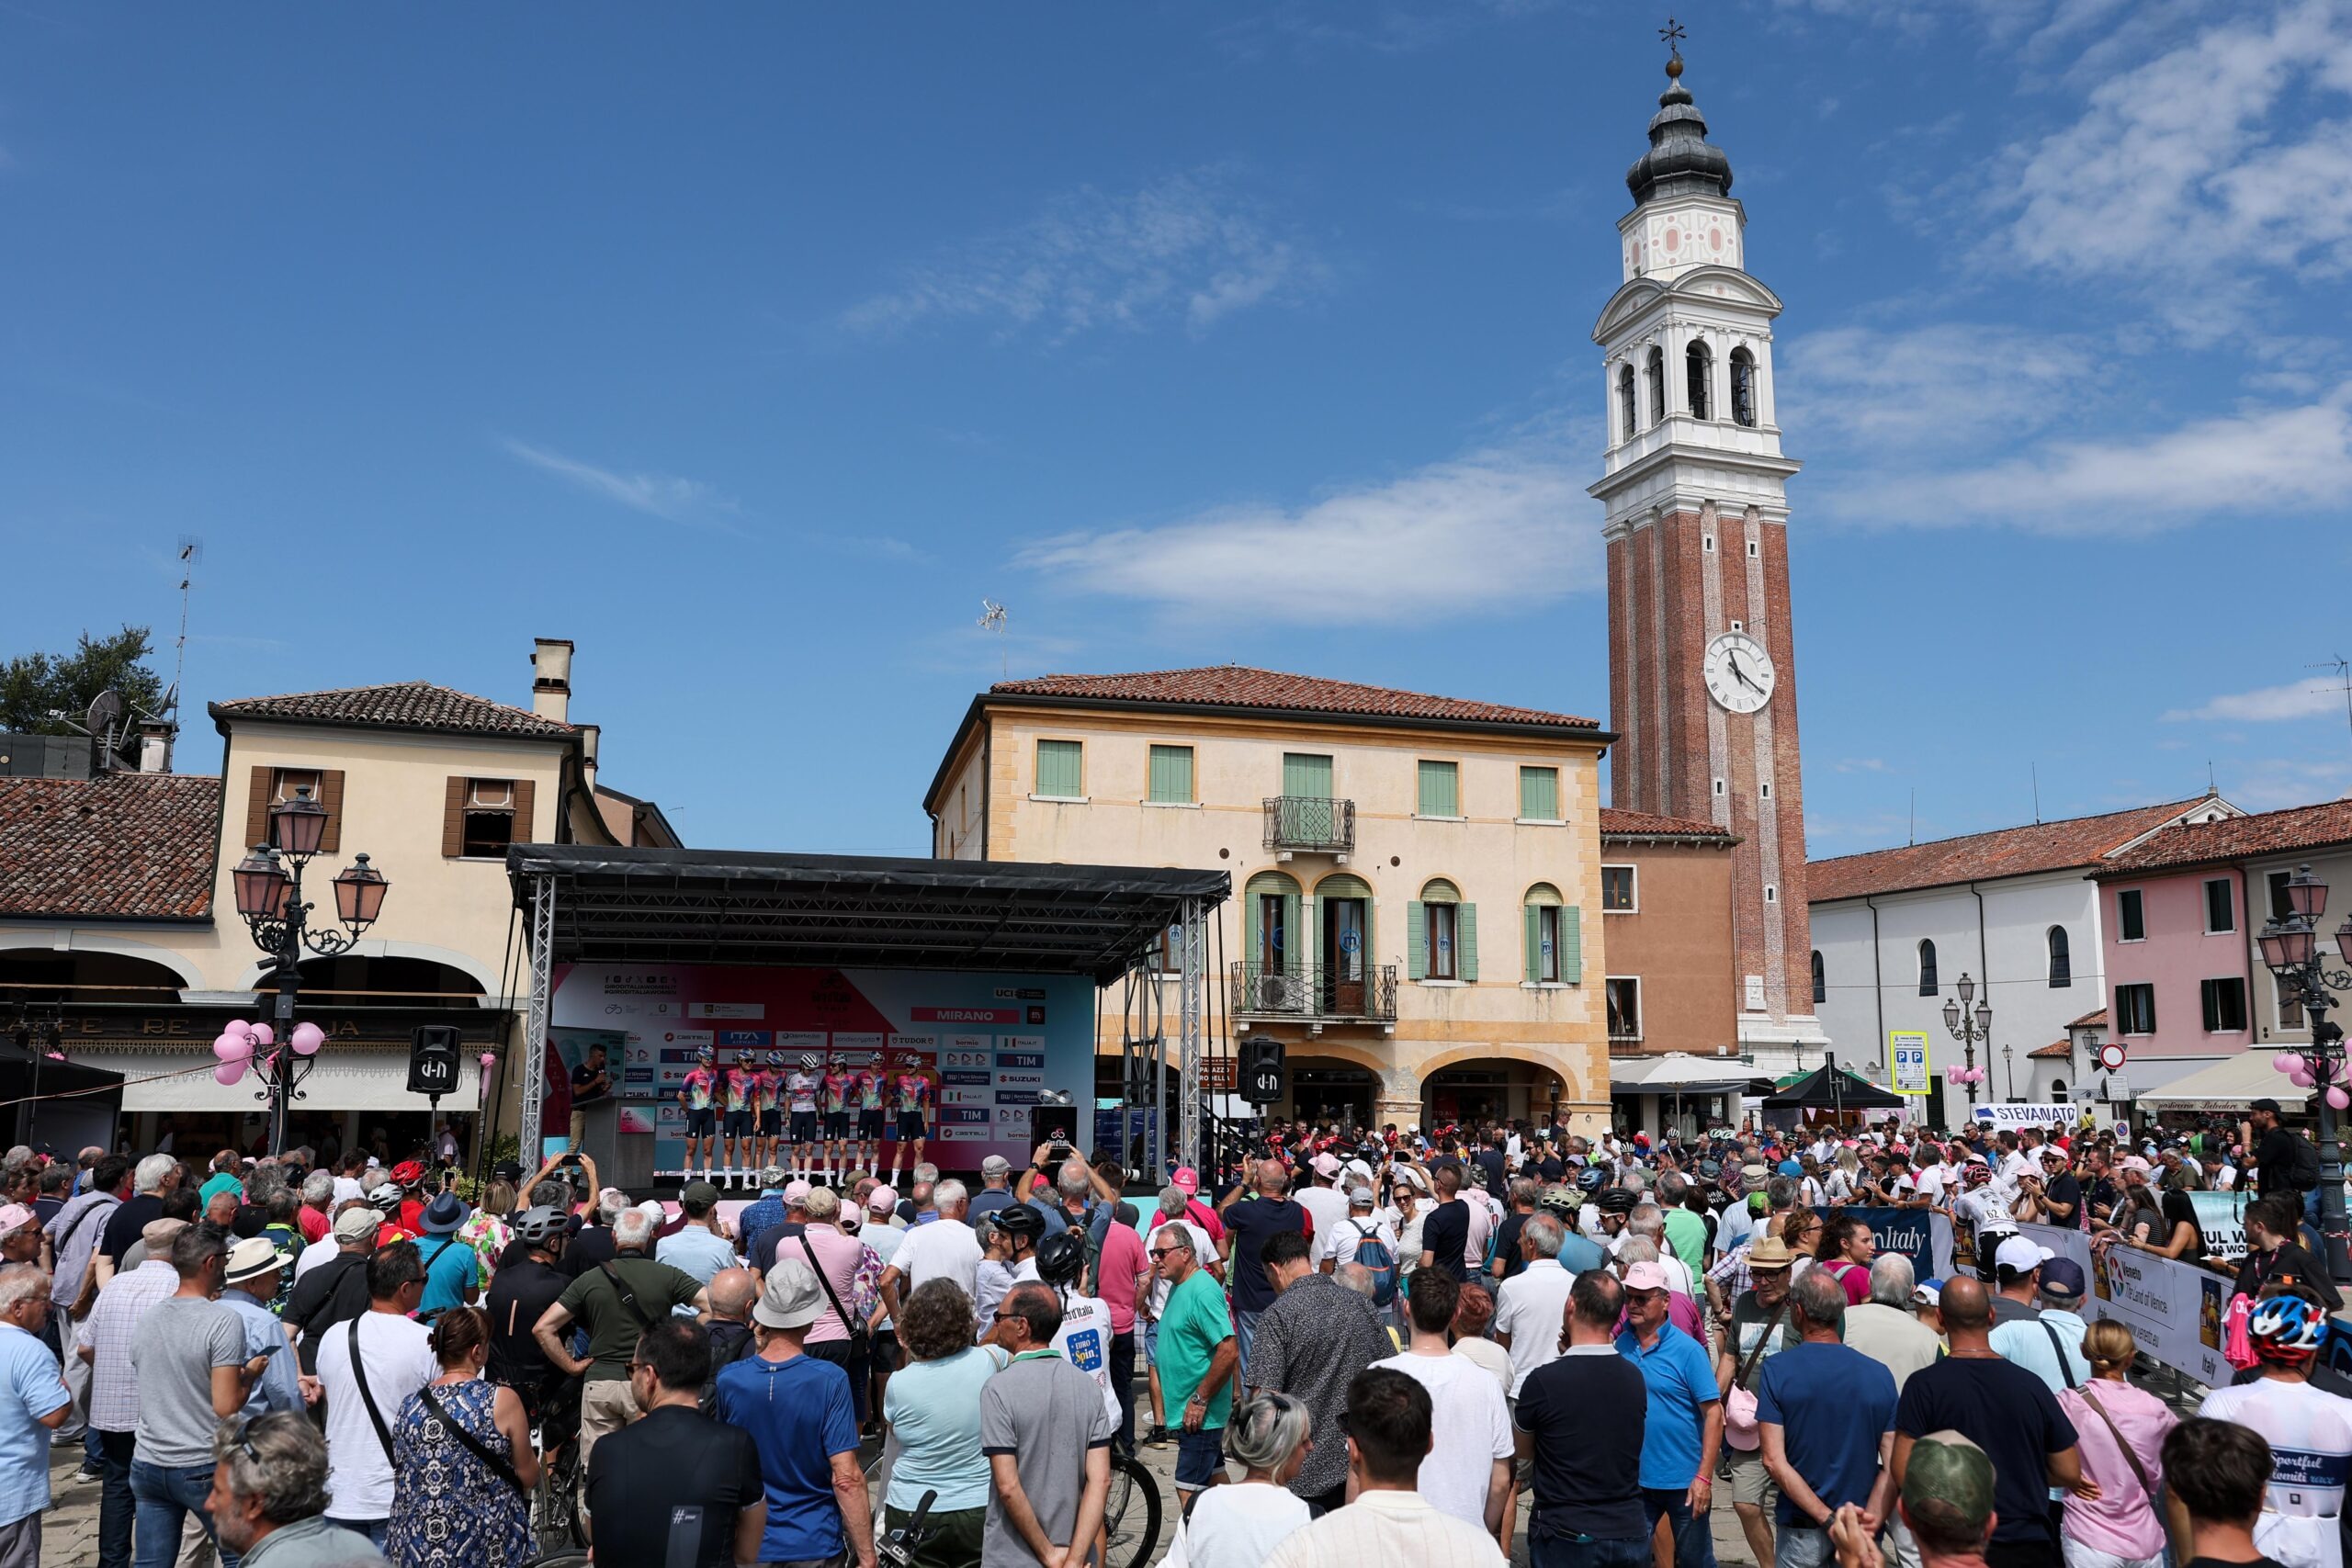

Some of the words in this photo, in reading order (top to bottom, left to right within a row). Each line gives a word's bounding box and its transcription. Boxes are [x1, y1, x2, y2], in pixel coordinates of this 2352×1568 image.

[996, 989, 1013, 998] UCI
[936, 1010, 994, 1021] MIRANO
[729, 1032, 760, 1040] ITA
[899, 1037, 927, 1045] TUDOR
[1016, 1056, 1036, 1066] TIM
[961, 1110, 981, 1121] TIM
[1996, 1107, 2075, 1122] STEVANATO
[1007, 1131, 1031, 1139] bormio
[1986, 1209, 1999, 1219] 62
[1871, 1225, 1927, 1258] nItaly
[2205, 1231, 2228, 1244] UL
[2120, 1259, 2143, 1282] Veneto
[2150, 1292, 2168, 1315] Venice
[1075, 1339, 1091, 1350] EURO
[1075, 1348, 1096, 1362] Spin
[2201, 1353, 2217, 1381] Italy
[2269, 1450, 2324, 1471] Sportful
[2271, 1468, 2308, 1483] lomiti
